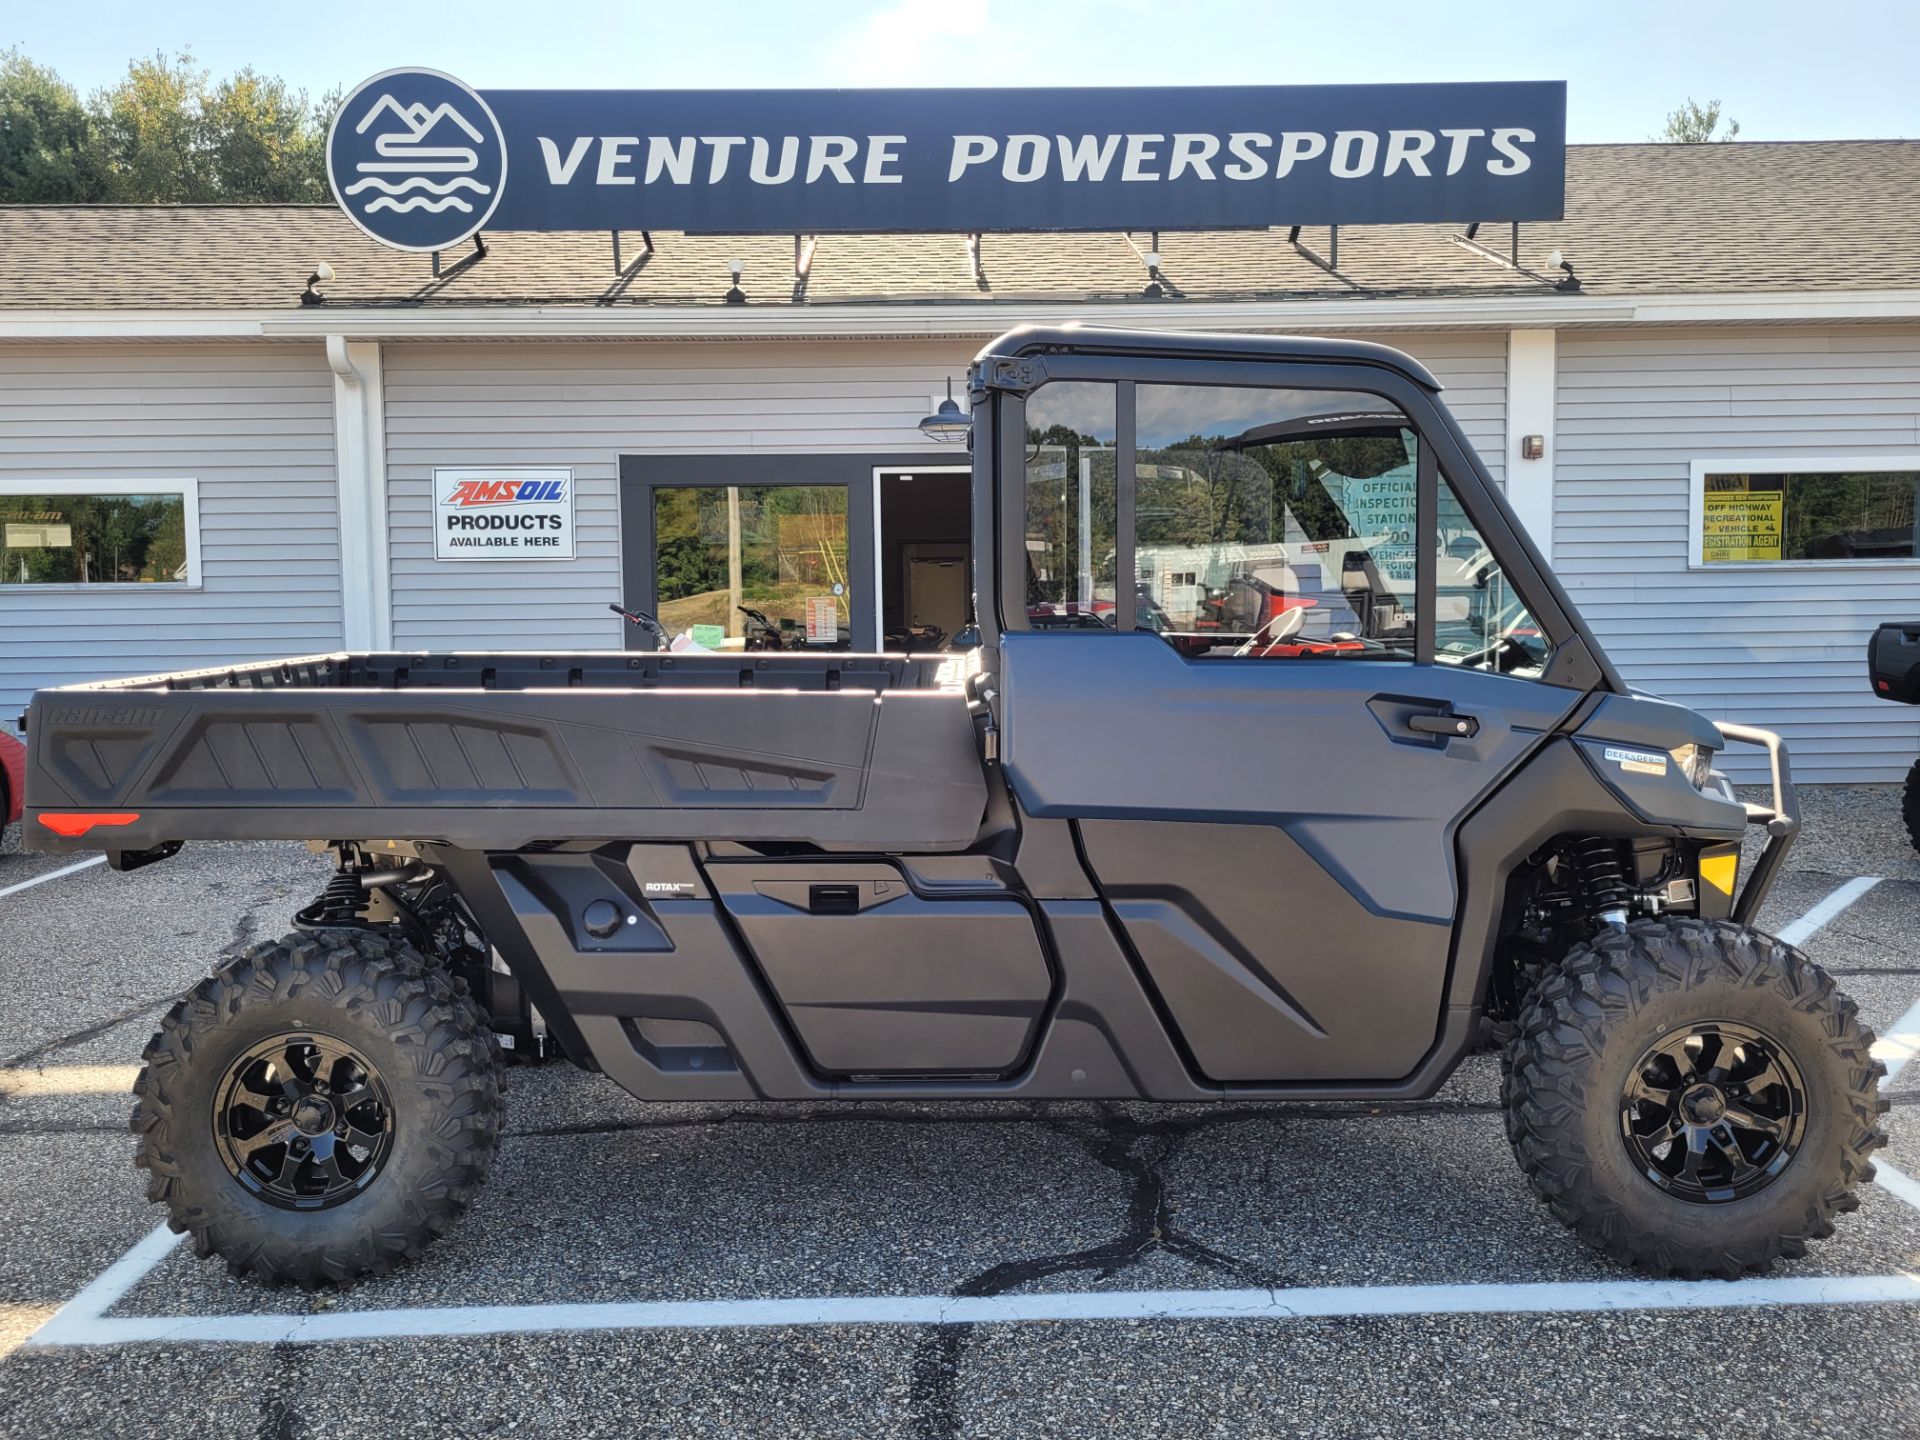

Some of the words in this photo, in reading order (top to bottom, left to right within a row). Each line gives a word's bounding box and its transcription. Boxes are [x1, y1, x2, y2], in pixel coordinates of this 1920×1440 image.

[536, 135, 907, 185] VENTURE
[947, 127, 1537, 183] POWERSPORTS
[447, 480, 562, 507] AMSOIL
[1355, 497, 1417, 509] INSPECTIO
[1728, 503, 1772, 511] HIGHWAY
[447, 515, 562, 530] PRODUCTS
[1367, 513, 1416, 524] STATION
[1704, 514, 1776, 522] RECREATIONAL
[449, 537, 519, 547] AVAILABLE
[524, 537, 560, 546] HERE
[1704, 536, 1752, 547] EGISTRATION
[1753, 535, 1779, 547] AGENT
[1370, 550, 1416, 560] VEHICLE
[1606, 750, 1654, 762] DEFENDER
[646, 883, 680, 891] ROTAX
